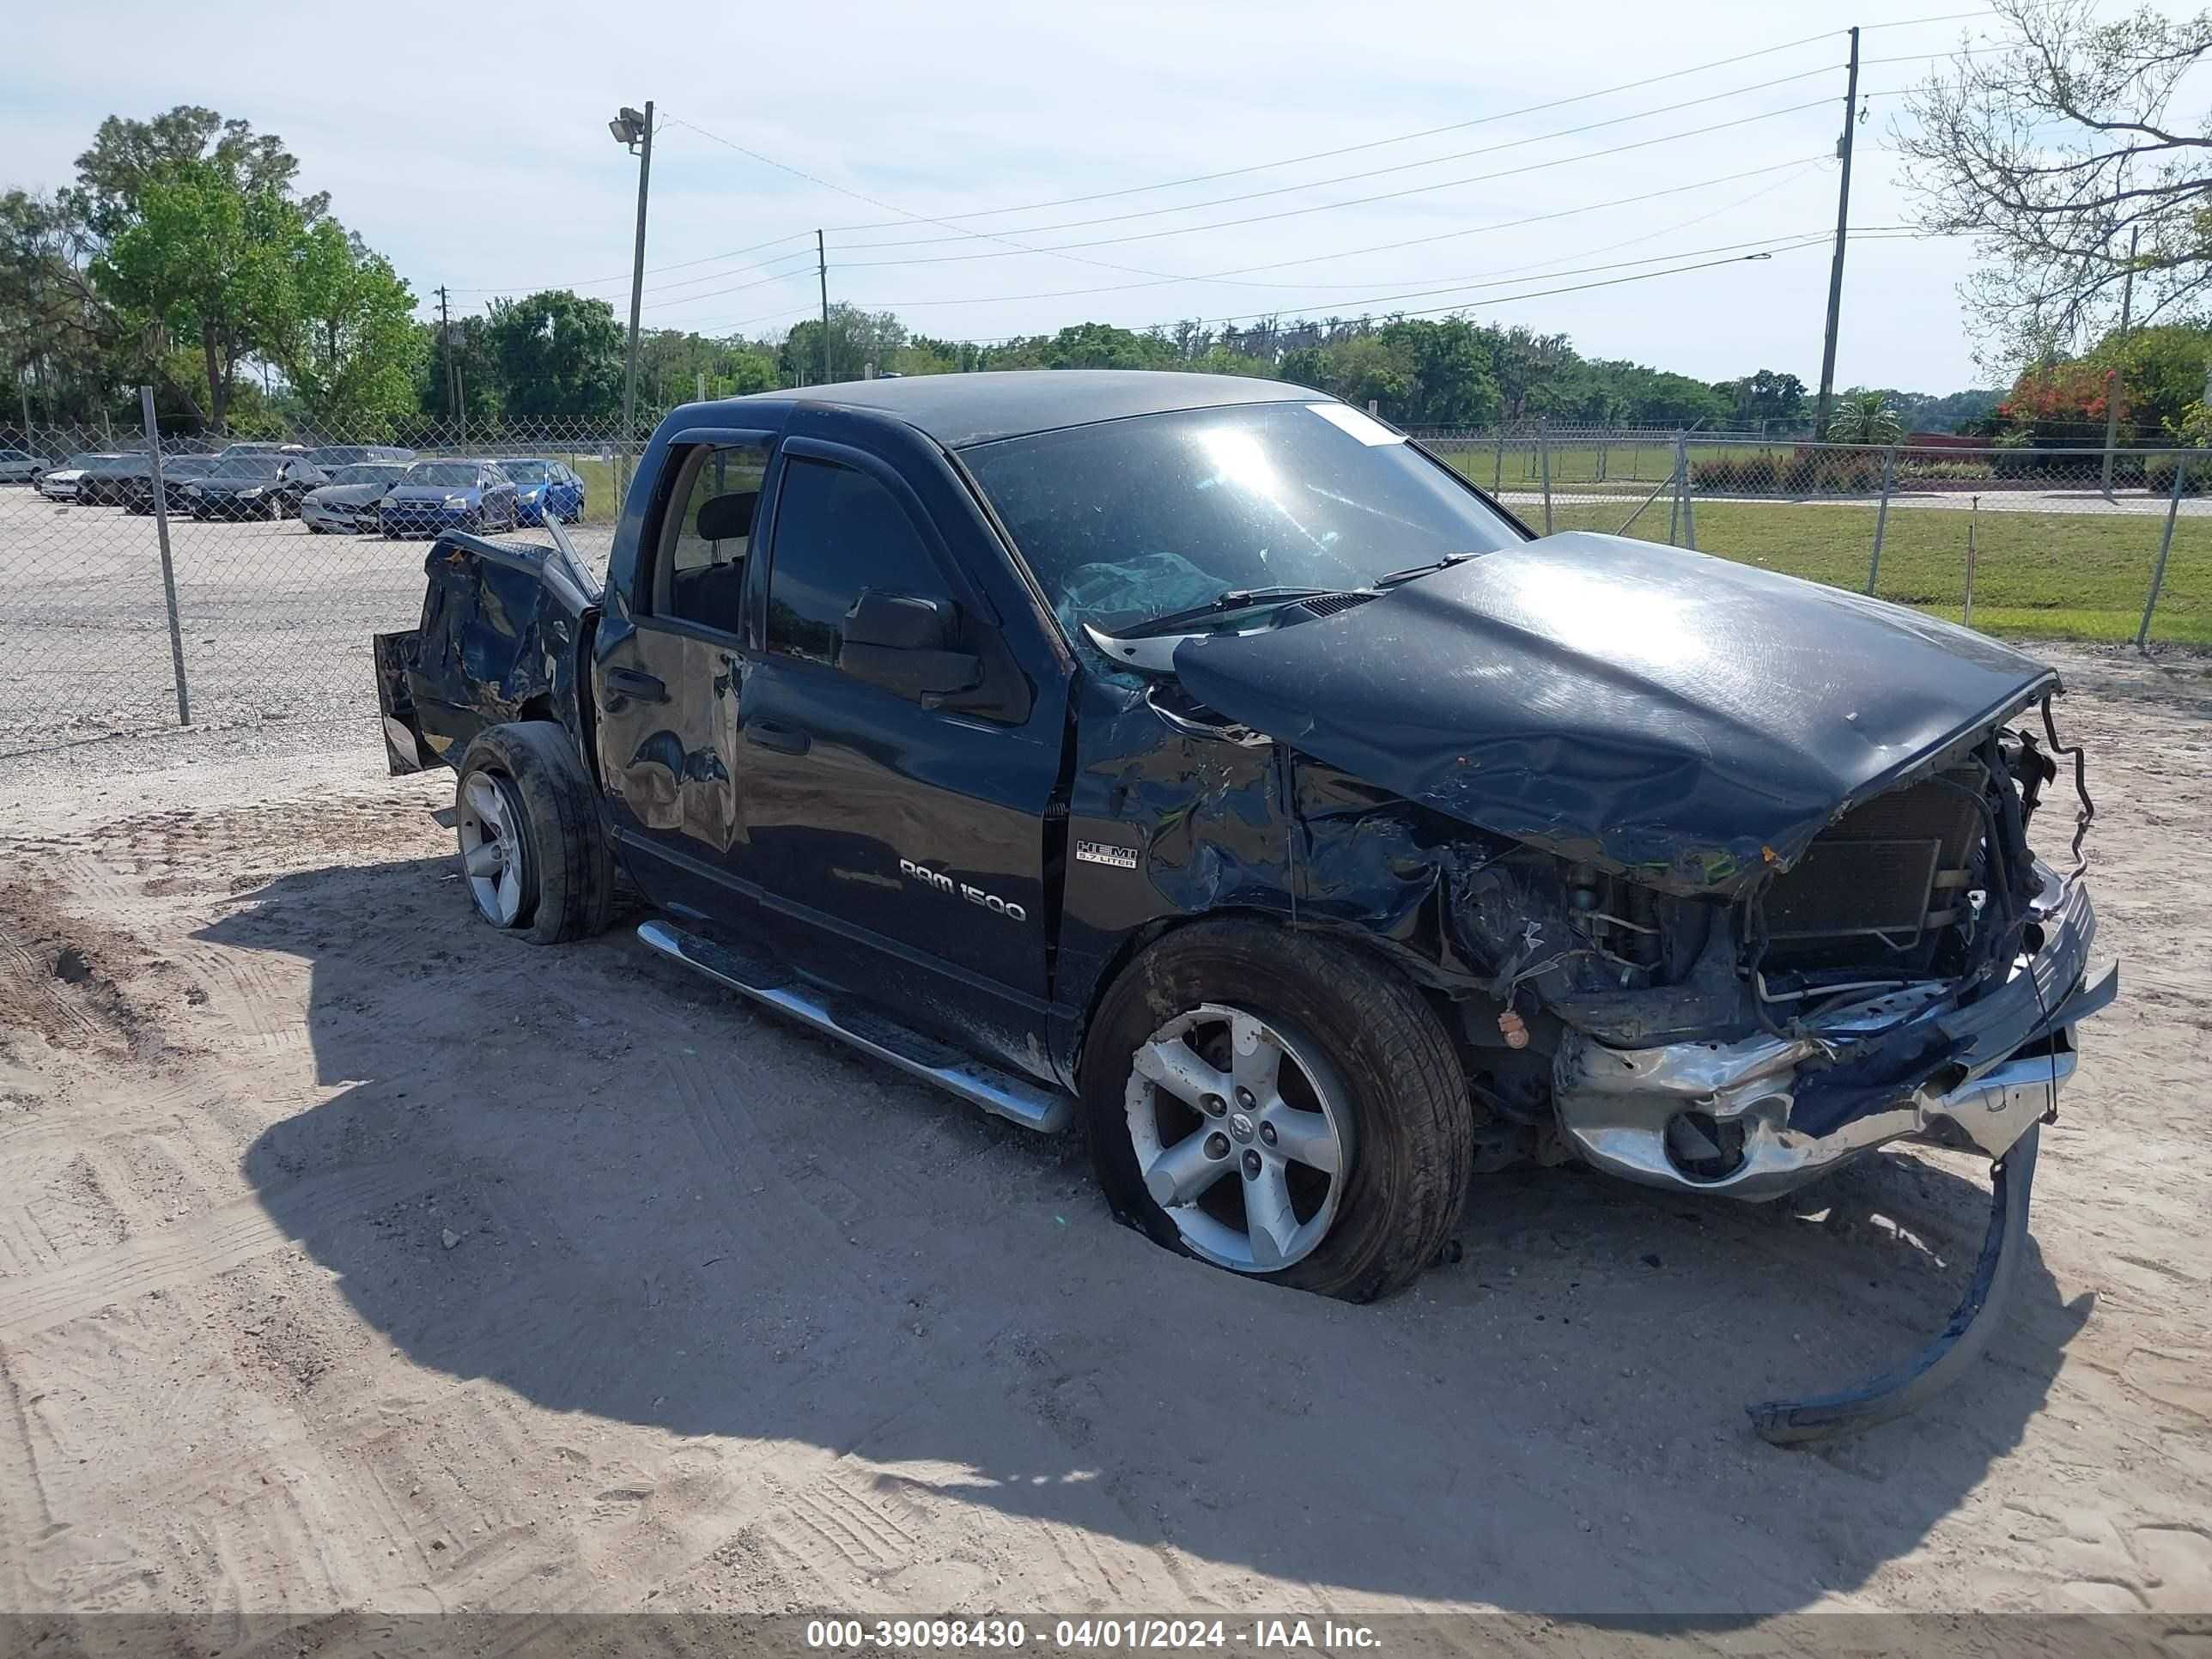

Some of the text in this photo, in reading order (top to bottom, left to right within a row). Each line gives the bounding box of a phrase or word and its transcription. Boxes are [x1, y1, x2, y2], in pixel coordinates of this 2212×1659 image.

[1076, 839, 1139, 860] HEMI
[1078, 852, 1133, 866] 5.7 LITER
[899, 858, 1027, 921] RAM 1500
